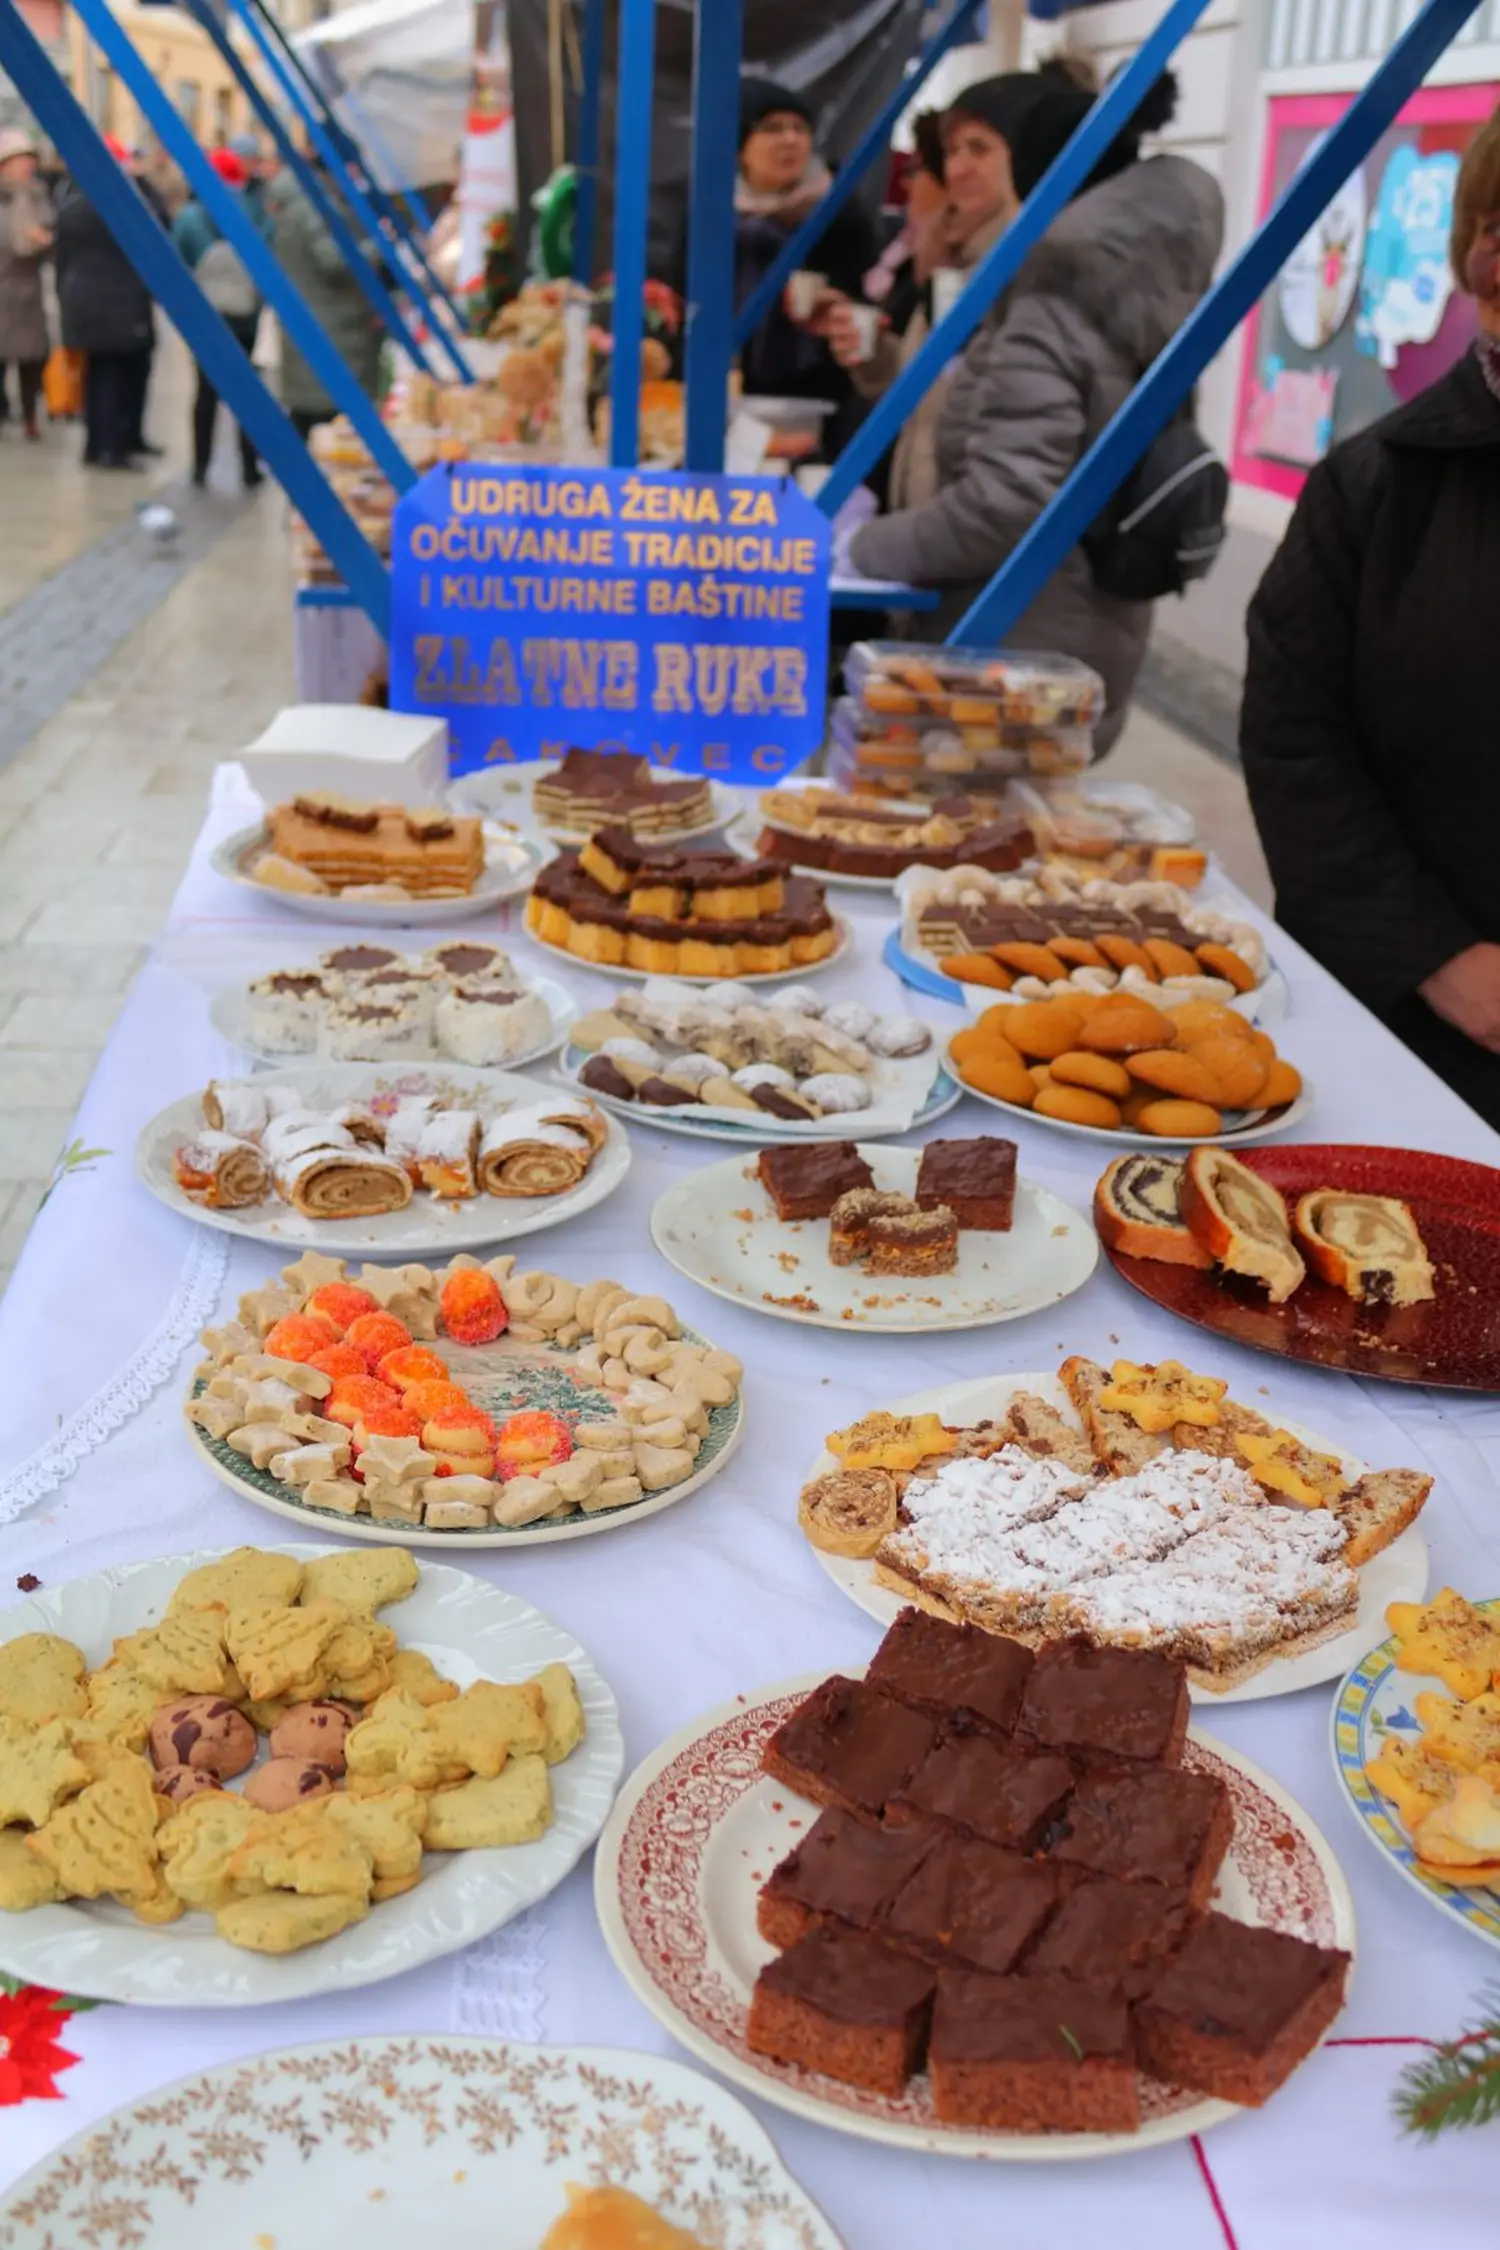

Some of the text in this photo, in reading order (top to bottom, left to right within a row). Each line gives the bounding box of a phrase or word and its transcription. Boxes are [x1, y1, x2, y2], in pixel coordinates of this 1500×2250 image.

[451, 475, 778, 526] UDRUGA ŽENA ZA
[410, 517, 816, 574] OČUVANJE TRADICIJE
[419, 574, 804, 620] I KULTURNE BAŠTINE
[414, 635, 807, 717] ZLATNE RUKE
